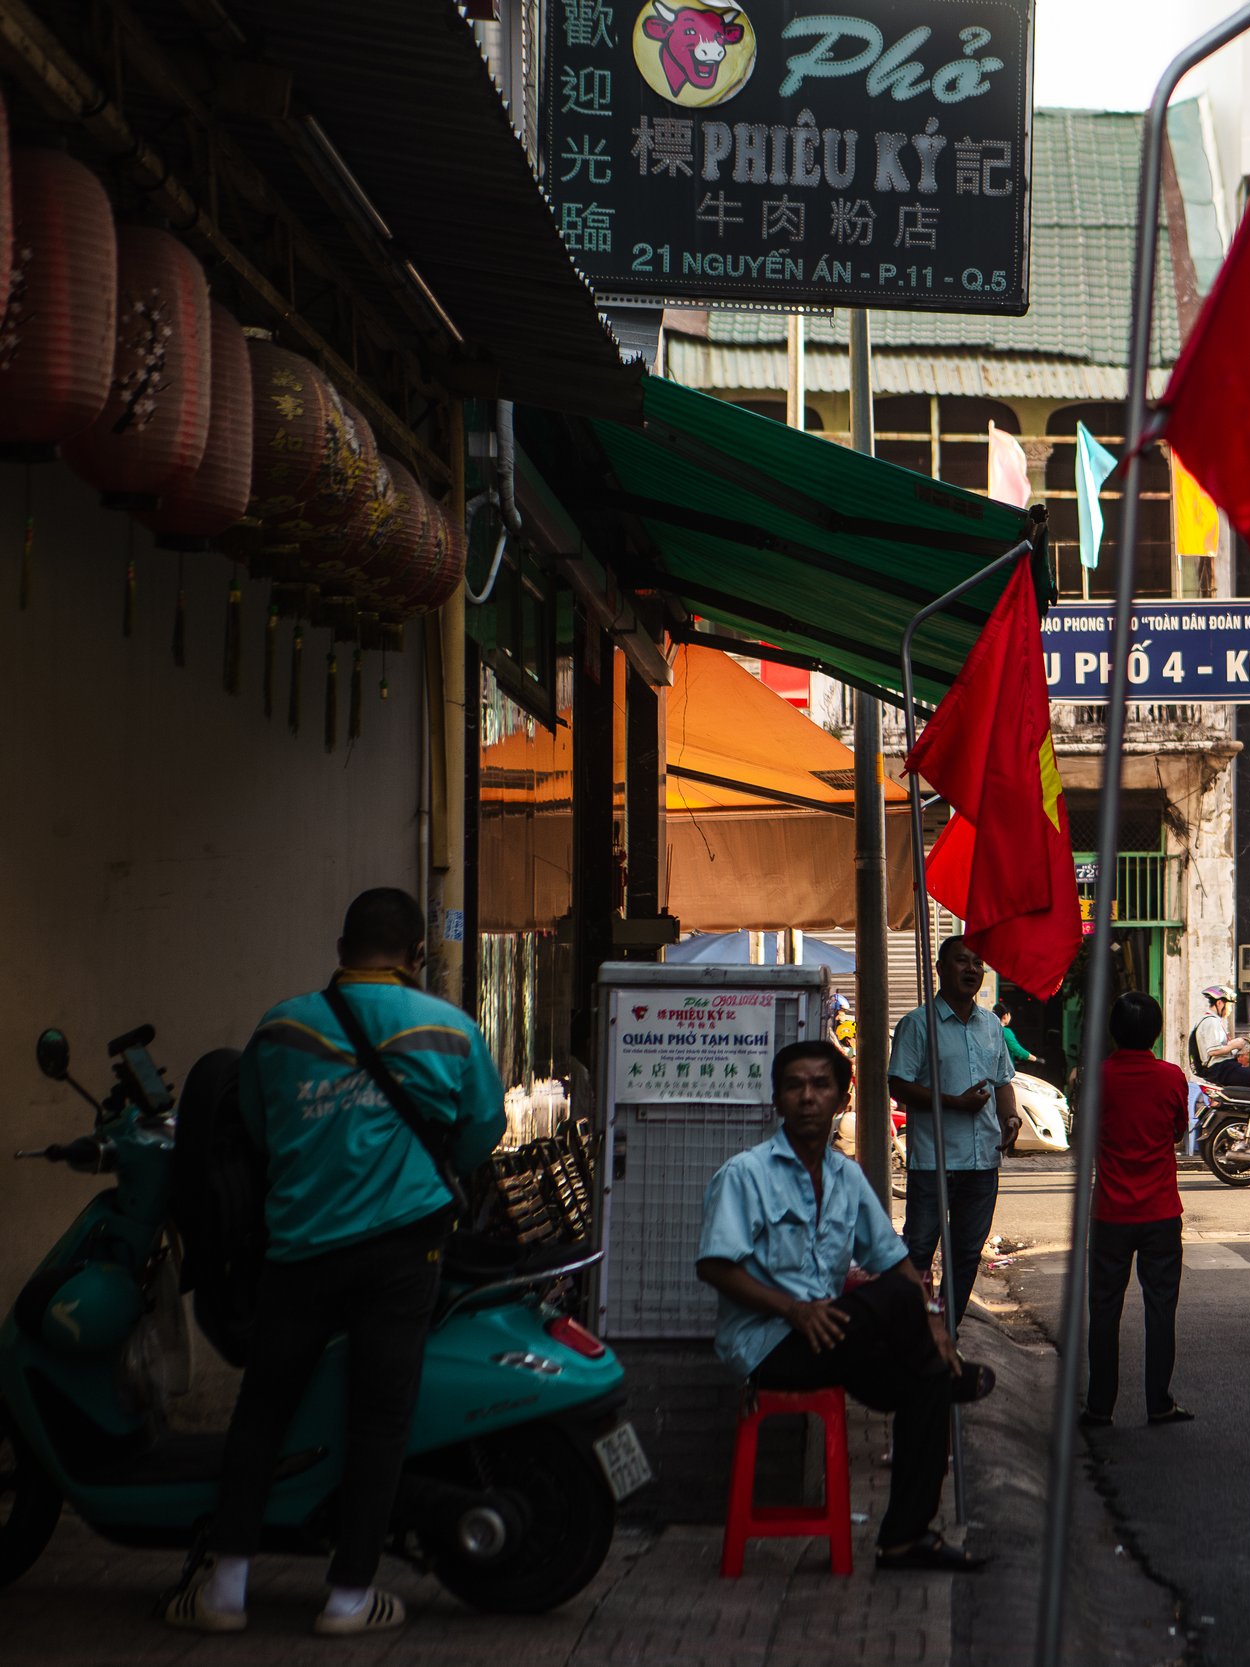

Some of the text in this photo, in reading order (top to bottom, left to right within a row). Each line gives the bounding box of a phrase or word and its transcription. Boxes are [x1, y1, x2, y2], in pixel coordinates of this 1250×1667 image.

[779, 15, 1004, 104] Phở
[701, 108, 859, 190] PHIÊU
[874, 117, 946, 194] KÝ
[697, 191, 942, 250] 牛肉粉店
[631, 243, 671, 273] 21
[682, 248, 804, 280] NGUYỄN
[812, 254, 852, 283] ÁN
[879, 263, 933, 288] P.11
[961, 267, 1007, 292] Q.5
[1064, 616, 1105, 632] PHONG
[1182, 612, 1207, 631] DÂN
[1209, 612, 1241, 630] ĐOÀN
[1162, 651, 1185, 683] 4
[622, 1031, 664, 1047] QUÁN
[700, 1033, 729, 1049] TẠM
